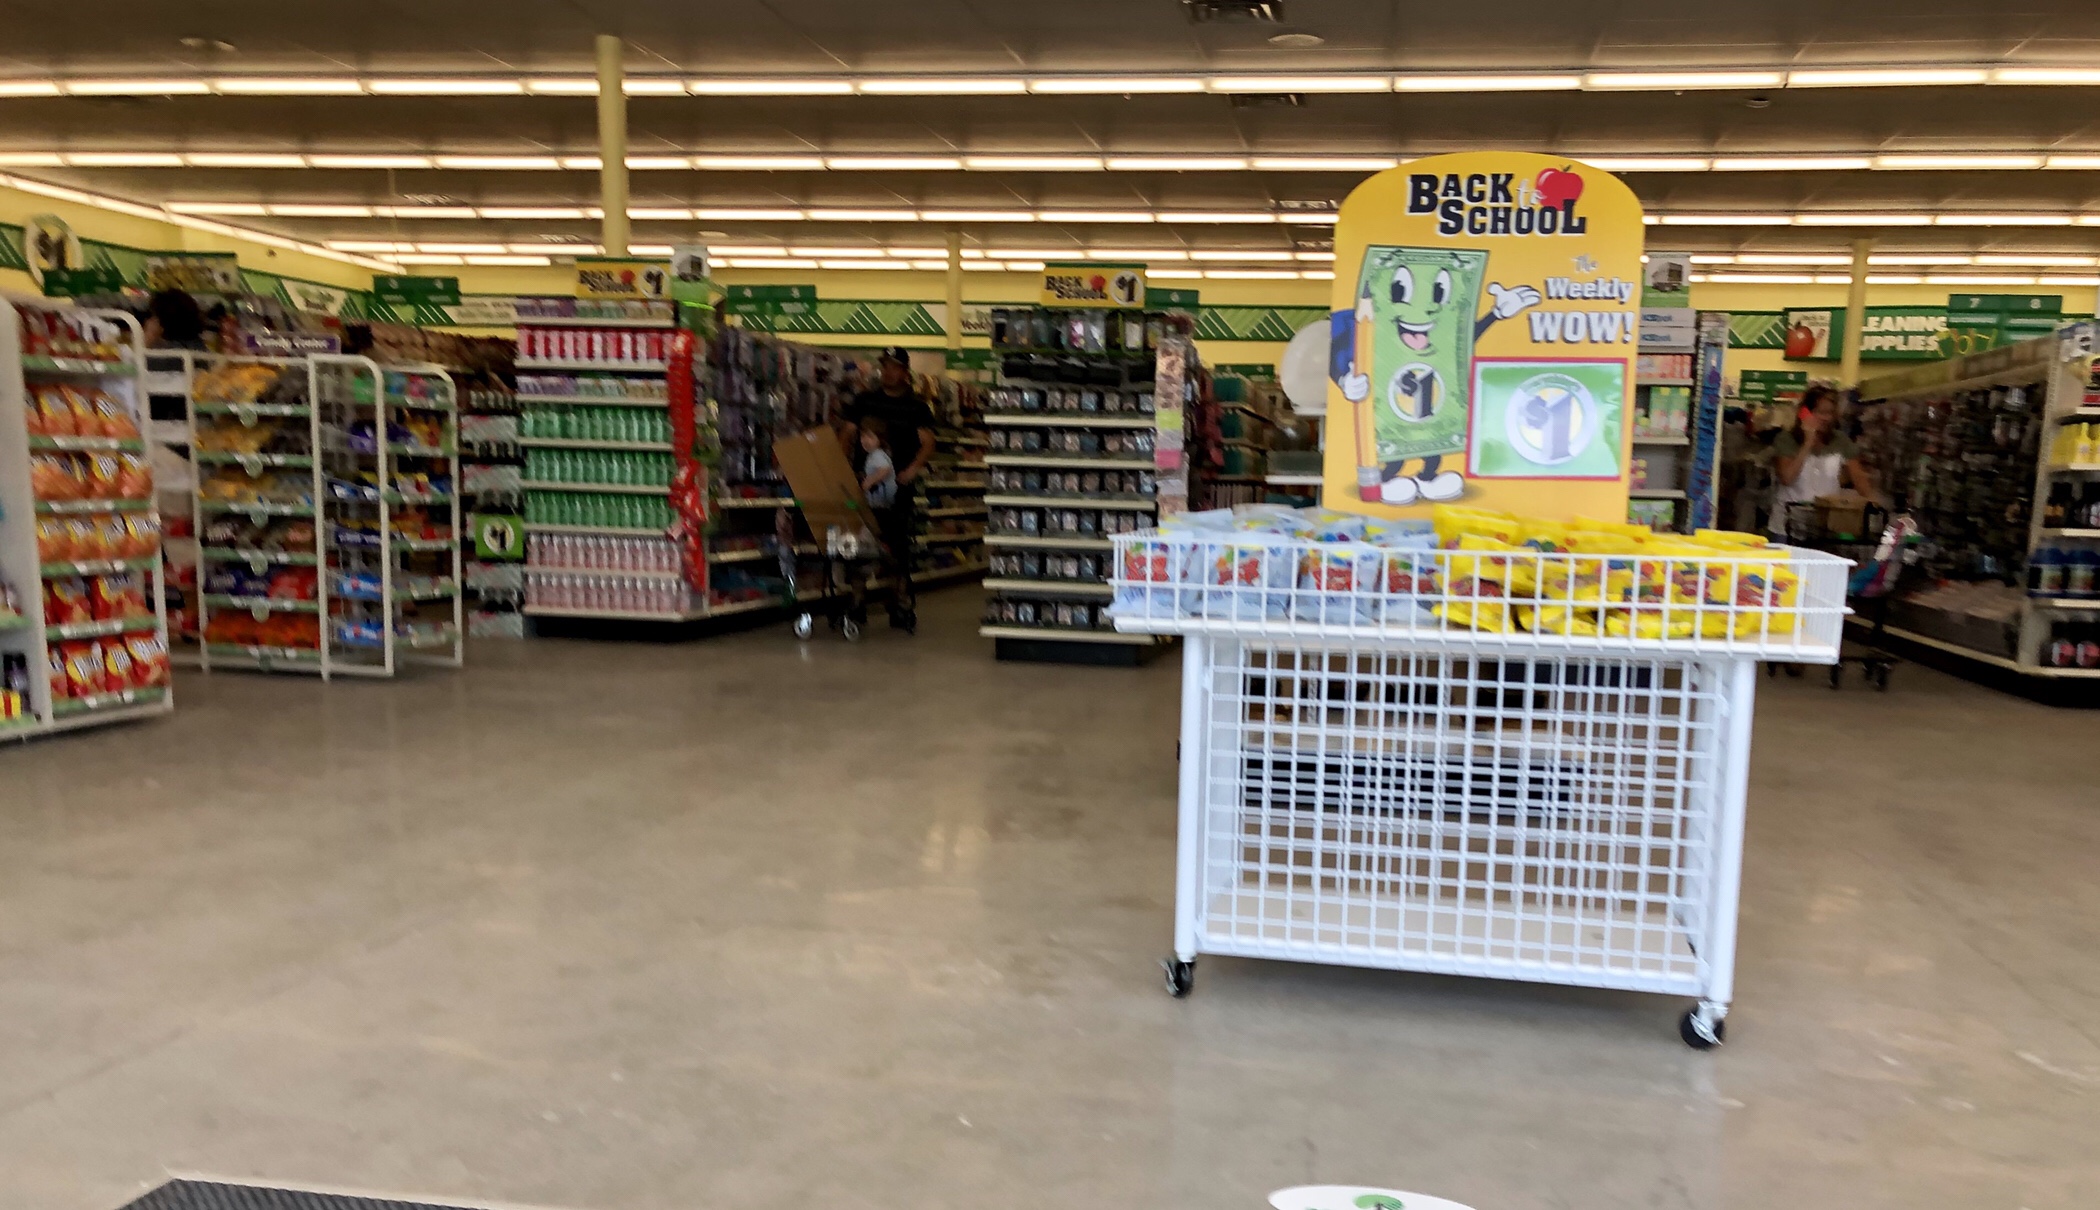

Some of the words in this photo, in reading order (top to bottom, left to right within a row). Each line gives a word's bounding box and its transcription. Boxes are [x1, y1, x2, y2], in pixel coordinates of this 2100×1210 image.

[1407, 174, 1514, 214] BACK
[1438, 199, 1588, 236] SCHOOL
[1544, 277, 1634, 304] Weekly
[1528, 312, 1635, 343] WOW!
[1396, 367, 1436, 419] $1
[1519, 390, 1572, 460] $1
